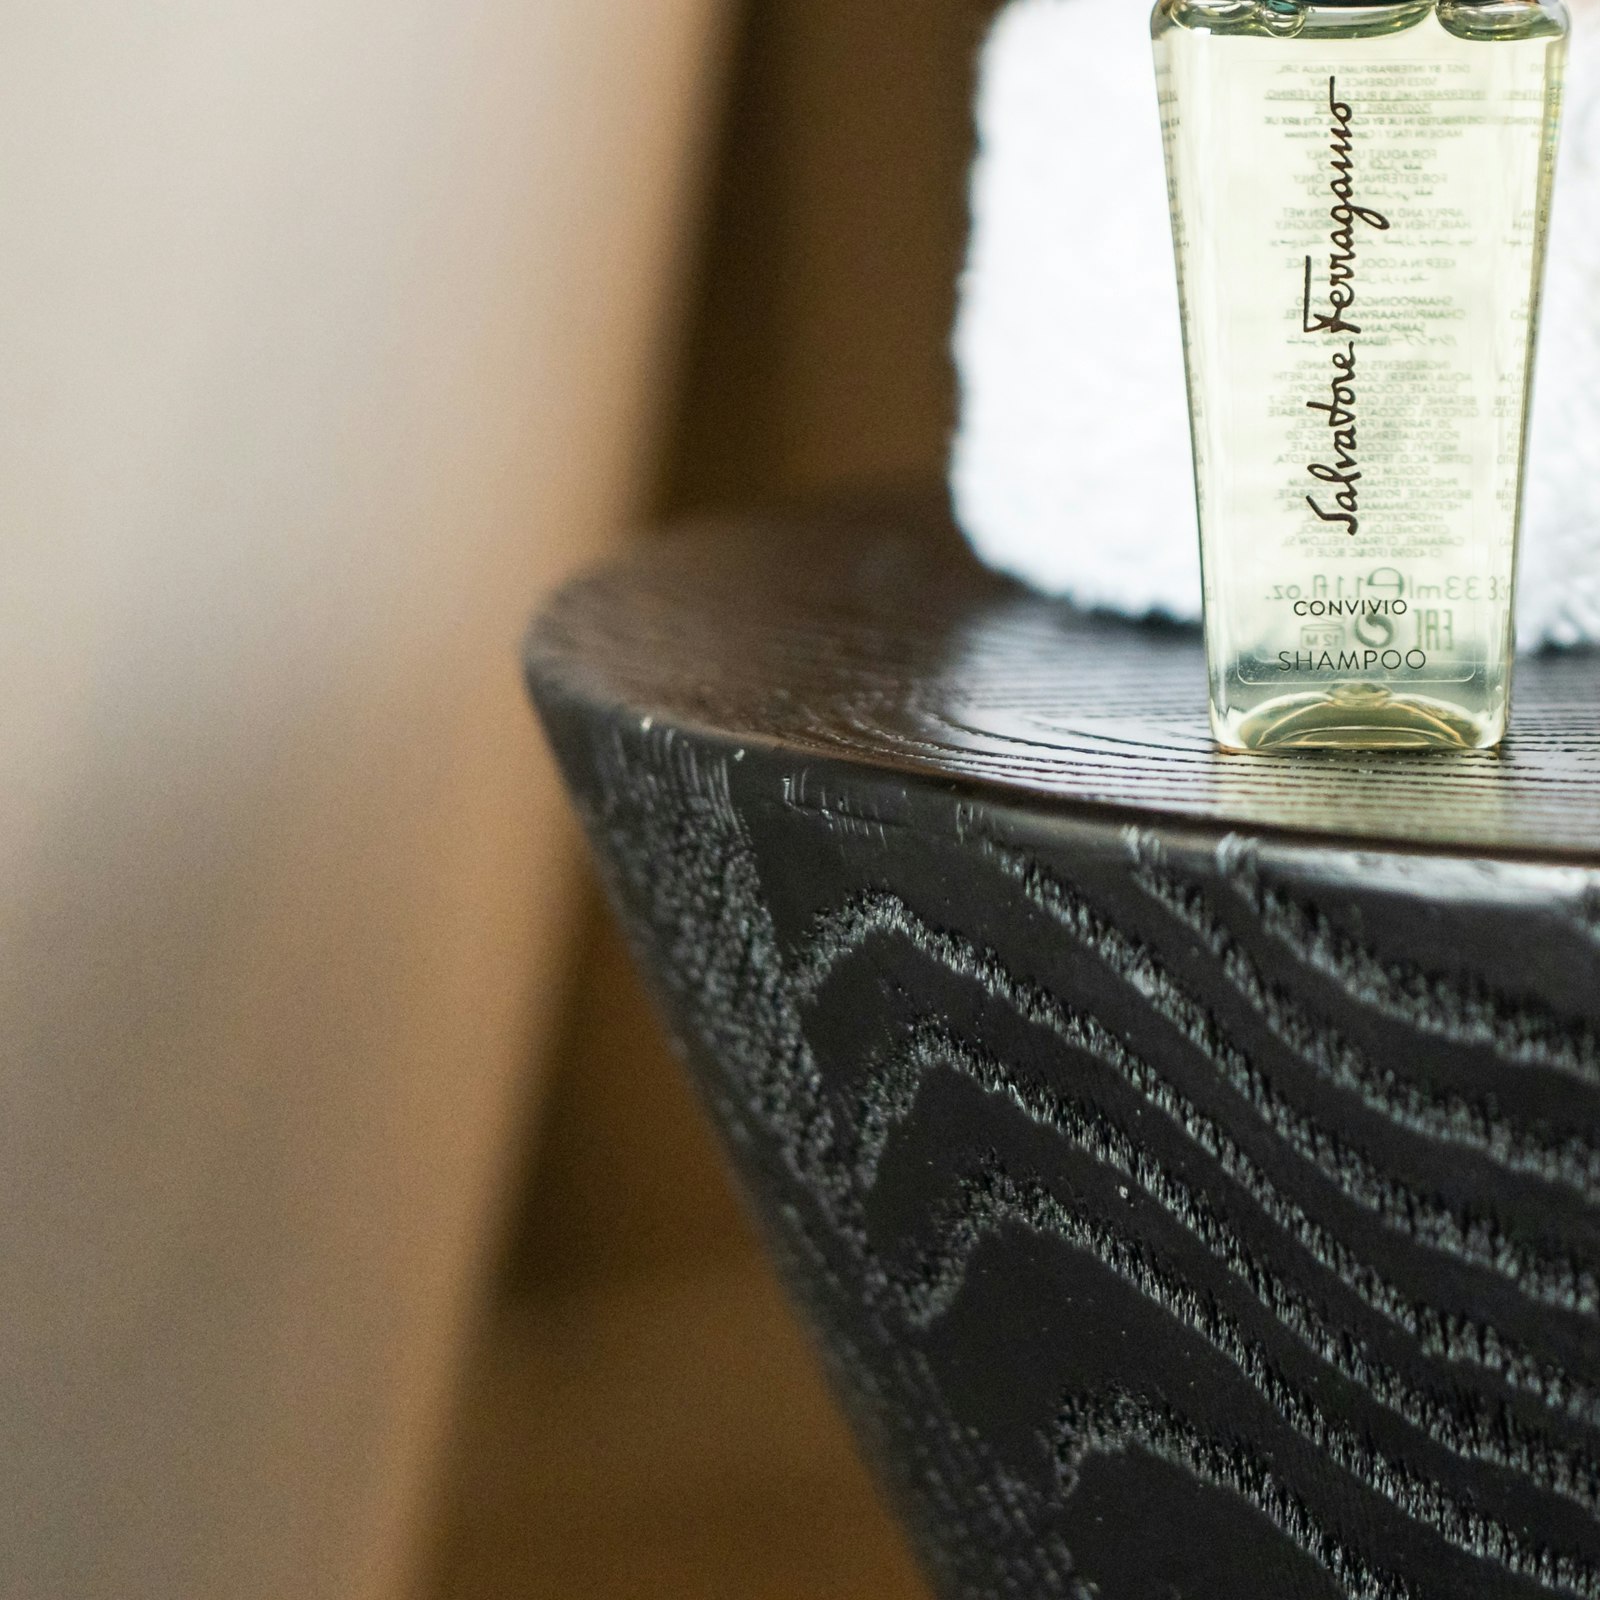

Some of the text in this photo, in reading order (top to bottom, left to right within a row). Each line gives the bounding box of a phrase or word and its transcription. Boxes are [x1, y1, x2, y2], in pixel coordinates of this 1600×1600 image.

[1303, 76, 1390, 334] Ferragamo
[1305, 341, 1362, 536] Salvatore
[1278, 649, 1427, 672] SHAMPOO
[1293, 599, 1407, 617] CONVIVIO
